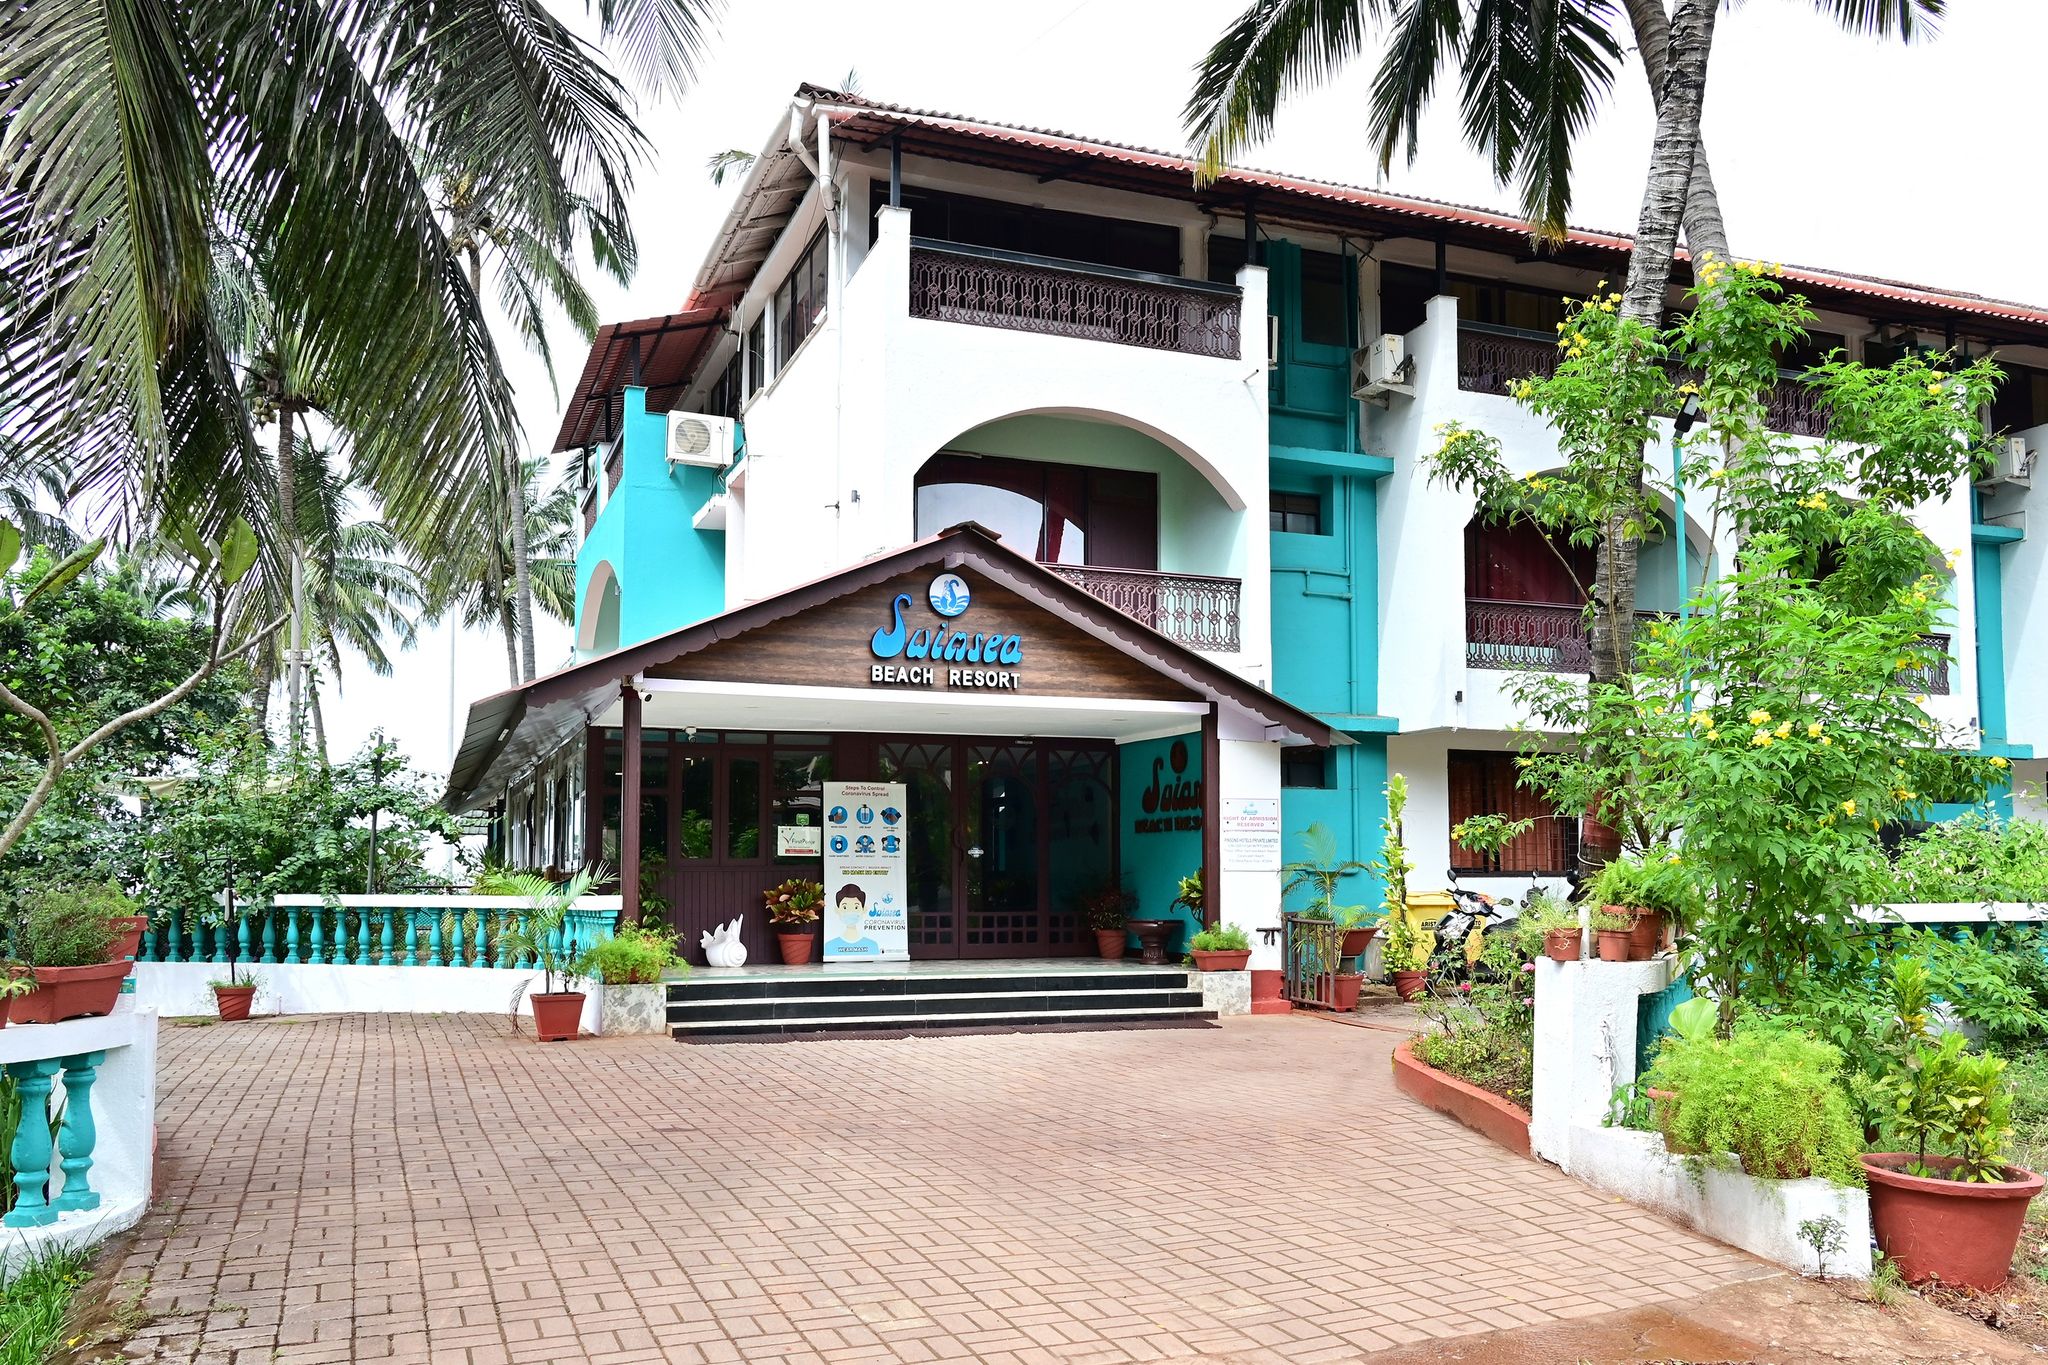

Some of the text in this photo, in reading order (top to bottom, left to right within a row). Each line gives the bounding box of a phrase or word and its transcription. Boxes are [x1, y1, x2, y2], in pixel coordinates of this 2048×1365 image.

[871, 593, 1023, 664] Swimsea
[871, 665, 1020, 688] BEACH RESORT
